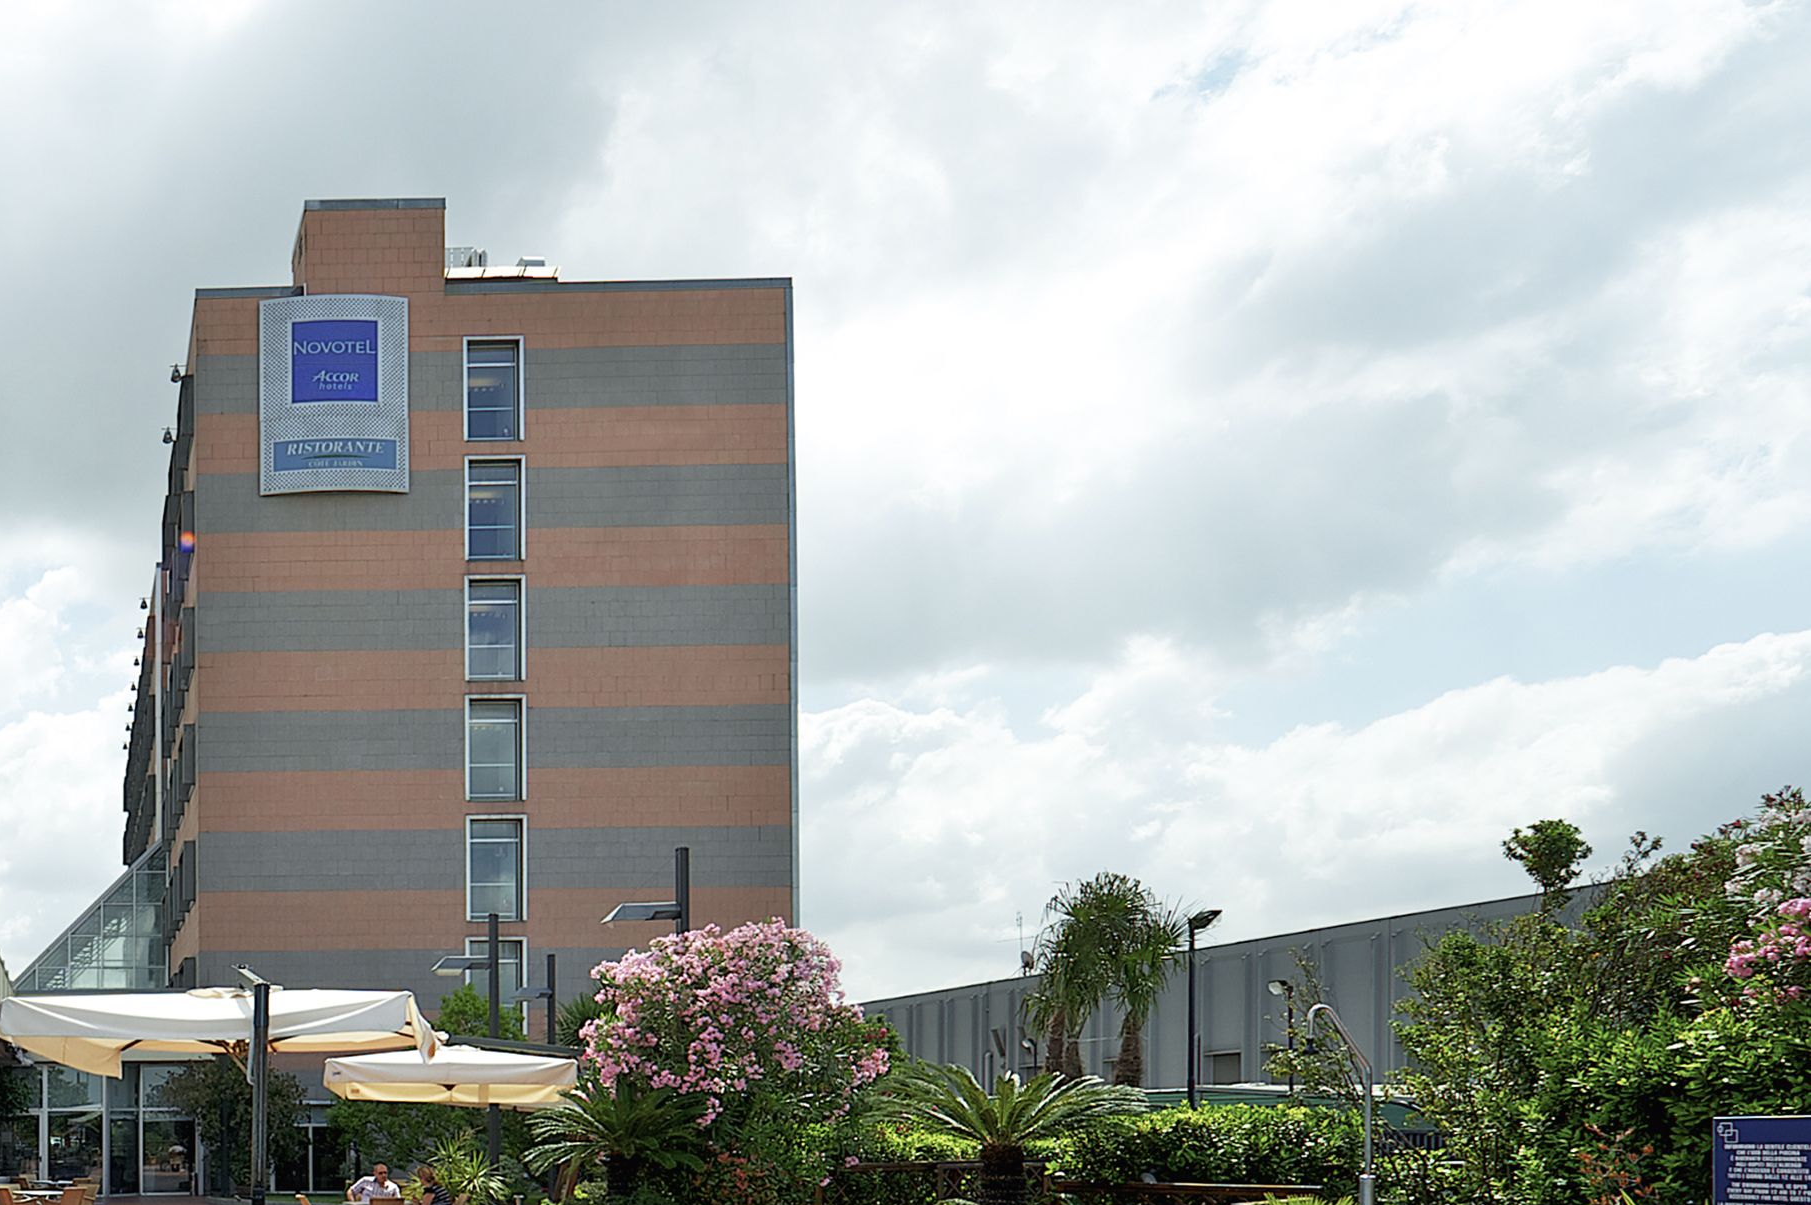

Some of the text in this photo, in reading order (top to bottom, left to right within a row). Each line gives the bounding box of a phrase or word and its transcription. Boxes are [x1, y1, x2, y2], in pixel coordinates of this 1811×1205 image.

[293, 340, 376, 355] NOVOTEL
[312, 370, 359, 382] ACCOR
[319, 382, 352, 390] hotels
[287, 441, 385, 455] RISTORANTE
